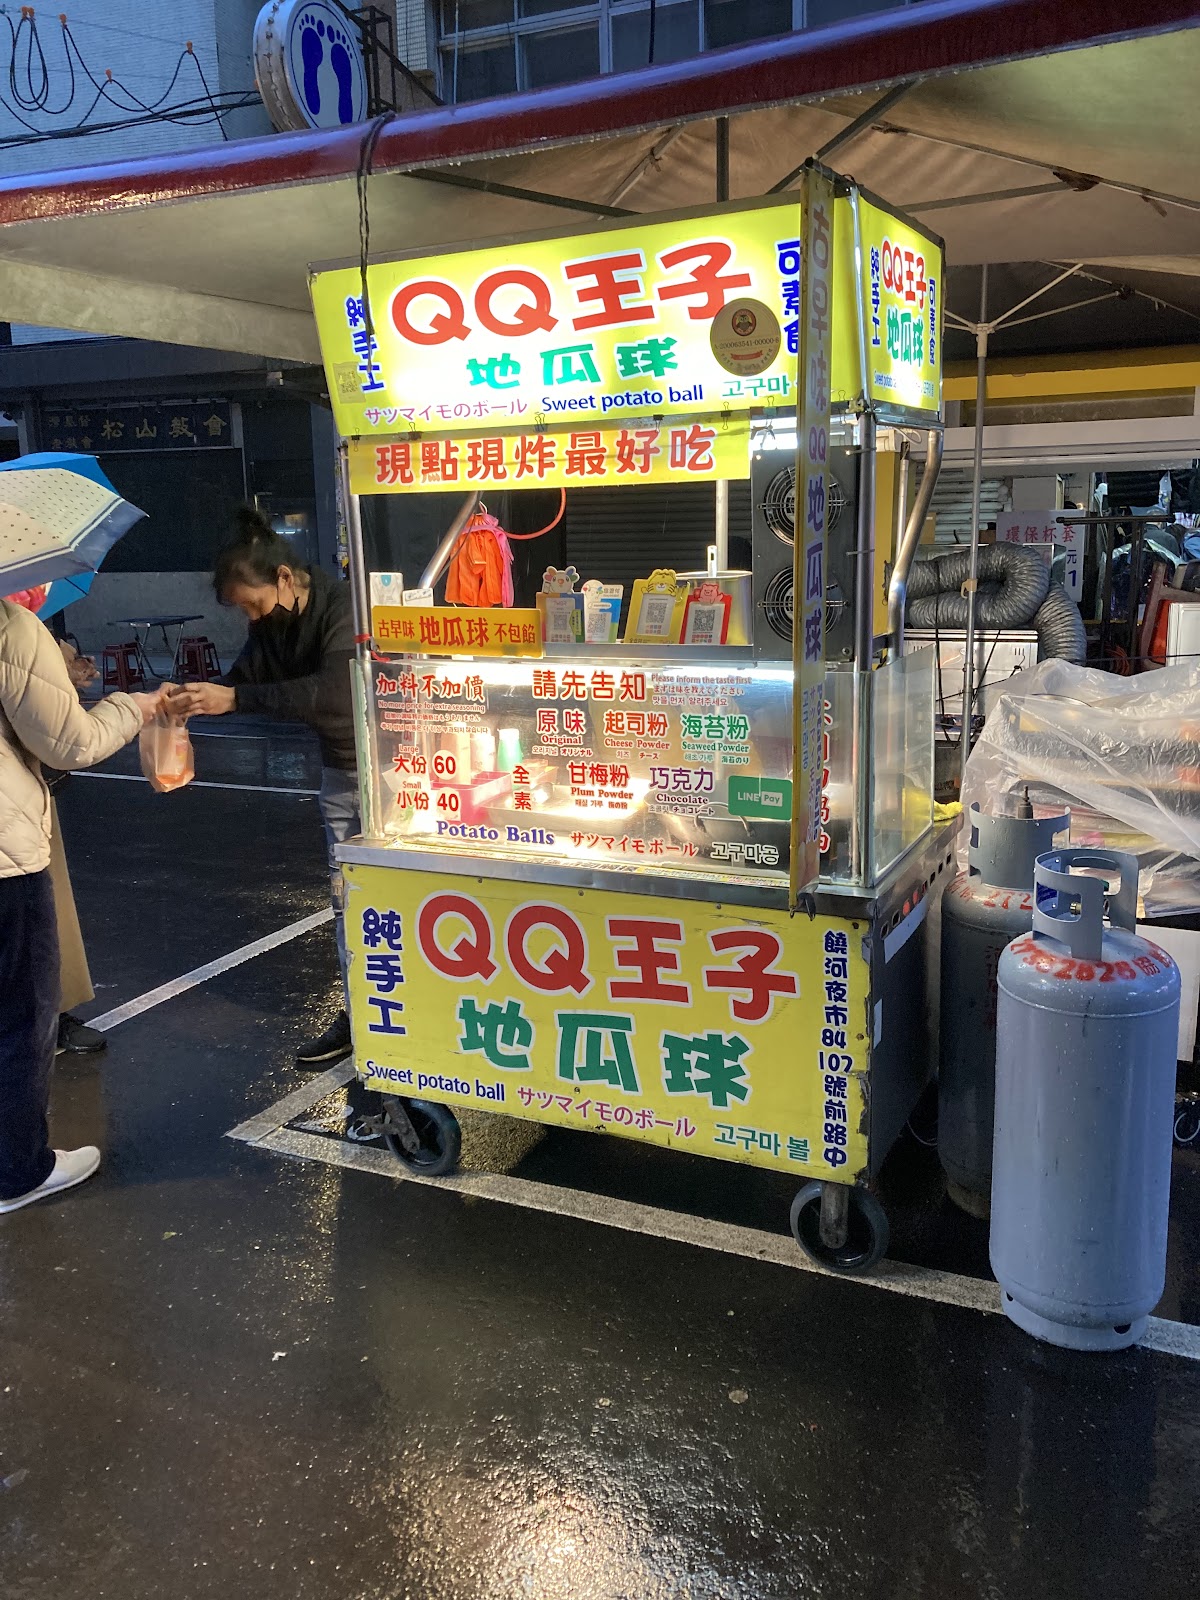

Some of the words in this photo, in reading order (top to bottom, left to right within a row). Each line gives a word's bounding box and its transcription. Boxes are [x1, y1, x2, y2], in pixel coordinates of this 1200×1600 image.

[881, 240, 927, 310] QQ王子
[392, 242, 752, 346] QQ王子
[887, 308, 924, 367] 地瓜球
[466, 336, 679, 389] 地瓜球
[541, 394, 596, 412] Sweet
[601, 389, 664, 412] potato
[669, 384, 704, 404] ball
[721, 375, 790, 398] 고구마
[364, 398, 528, 425] サツマイモのボール
[375, 424, 717, 485] 現點現炸最好吃
[1005, 525, 1077, 543] 環保杯套
[378, 618, 416, 640] 古早味
[419, 615, 490, 648] 地瓜球
[494, 622, 537, 644] 不包餡
[376, 672, 486, 701] 加料不加價
[532, 669, 646, 702] 請先告知
[651, 673, 675, 683] Please
[676, 675, 701, 684] inform
[702, 676, 716, 684] the
[716, 677, 735, 685] taste
[388, 702, 405, 710] more
[406, 702, 422, 711] price
[424, 702, 434, 710] for
[434, 703, 453, 711] extra
[453, 704, 485, 714] seasoning
[536, 709, 585, 734] 原味
[604, 711, 668, 737] 起司粉
[681, 714, 749, 740] 海苔粉
[398, 744, 419, 754] Large
[541, 734, 583, 746] Original
[604, 737, 633, 748] Cheese
[636, 739, 670, 750] Powder
[682, 740, 717, 751] Seaweed
[718, 742, 750, 753] Powder
[393, 755, 427, 774] 大份
[434, 755, 457, 775] 60
[560, 749, 593, 758] オリジナル
[402, 780, 422, 789] Small
[567, 762, 630, 788] 甘梅粉
[649, 767, 714, 792] 巧克力
[397, 791, 430, 810] 小份
[511, 765, 533, 811] 全素
[570, 786, 595, 797] Plum
[597, 789, 634, 800] Powder
[656, 793, 709, 805] Chocolate
[737, 791, 760, 802] LINE
[764, 794, 780, 804] Pay
[437, 792, 459, 812] 40
[673, 806, 714, 815] チョコレート
[436, 821, 499, 841] Potato
[506, 826, 555, 846] Balls
[710, 841, 781, 865] 고구마공
[418, 894, 797, 1020] QQ王子
[362, 907, 406, 1035] 純手工
[458, 998, 750, 1107] 地瓜球
[366, 1060, 413, 1085] Sweet
[418, 1072, 471, 1096] potato
[475, 1079, 505, 1101] ball
[517, 1086, 697, 1138] サツマイモのボール
[714, 1122, 781, 1157] 고구마
[787, 1136, 810, 1162] 볼
